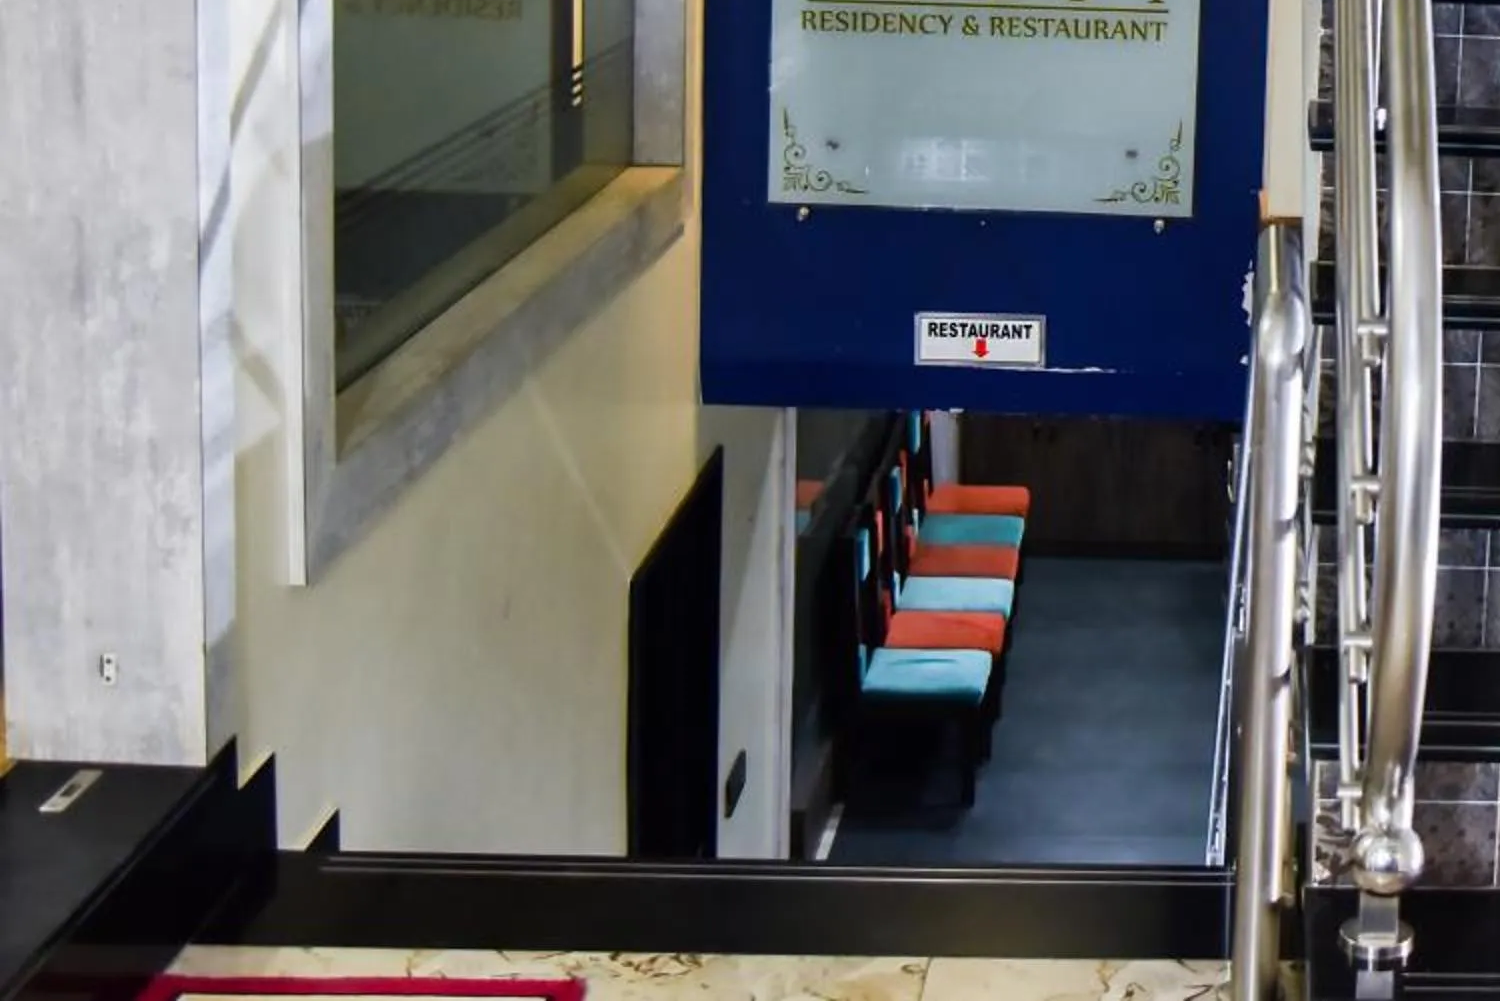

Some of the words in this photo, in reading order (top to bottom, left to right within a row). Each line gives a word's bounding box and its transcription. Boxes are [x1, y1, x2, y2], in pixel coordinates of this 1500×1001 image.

[801, 9, 953, 36] RESIDENCY
[961, 13, 980, 37] &
[990, 15, 1168, 42] RESTAURANT
[927, 321, 1033, 340] RESTAURANT
